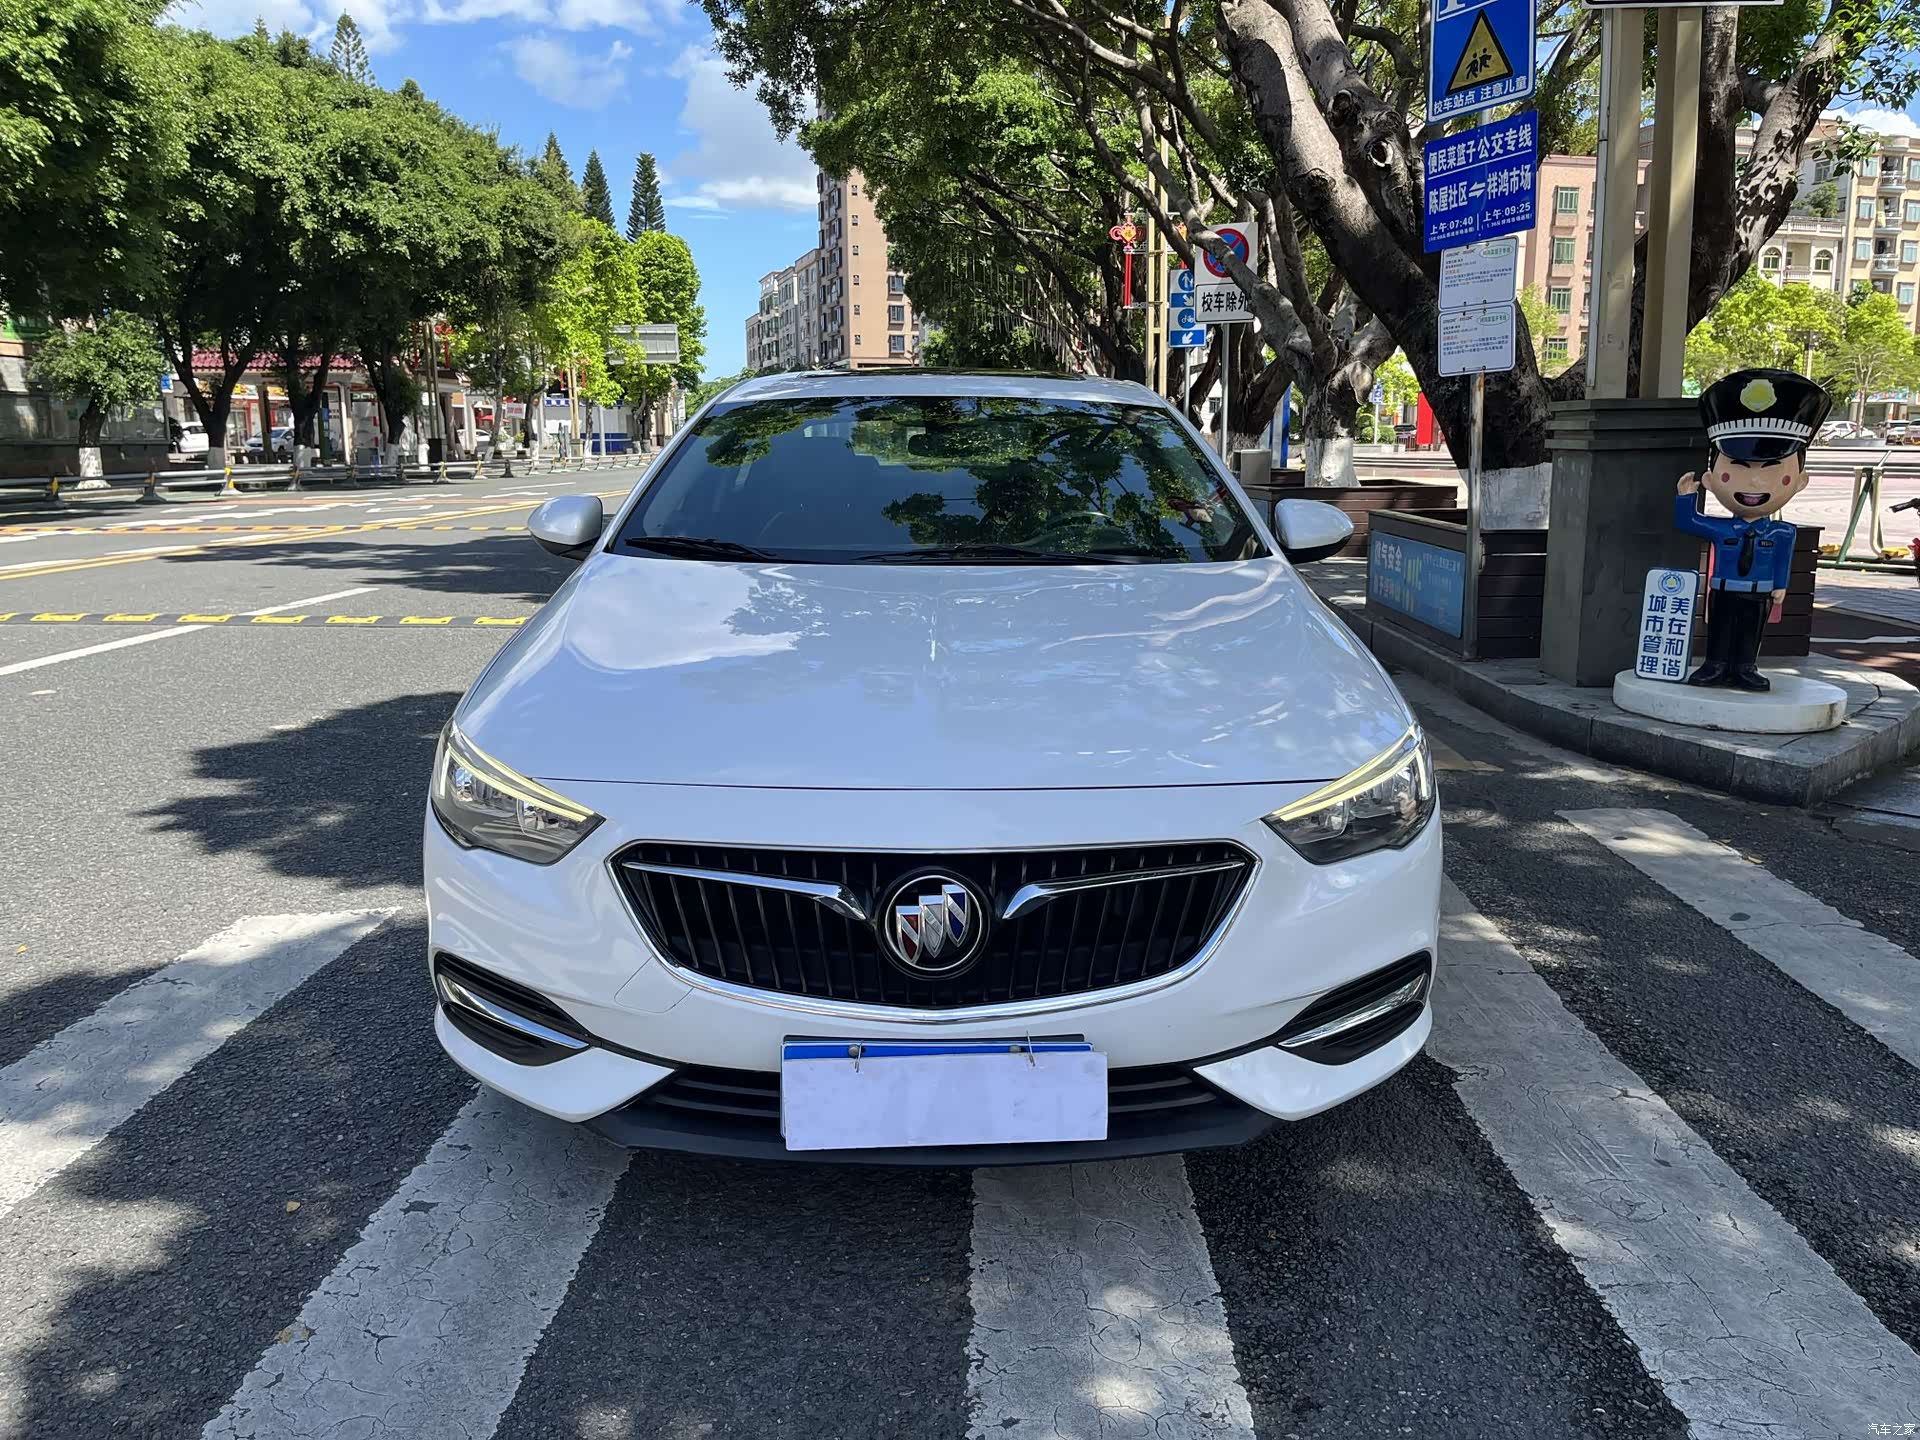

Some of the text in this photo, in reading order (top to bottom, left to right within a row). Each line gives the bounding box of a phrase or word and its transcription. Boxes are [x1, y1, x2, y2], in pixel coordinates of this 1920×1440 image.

[1433, 75, 1527, 115] 校车站点 注意儿童
[1427, 123, 1532, 175] 便民菜篮子公交专线
[1428, 163, 1532, 216] 陈屋社区 祥鸿市场
[1201, 291, 1249, 313] 校车除外
[1639, 594, 1667, 674] 城市管理
[1662, 596, 1690, 677] 美在和谐
